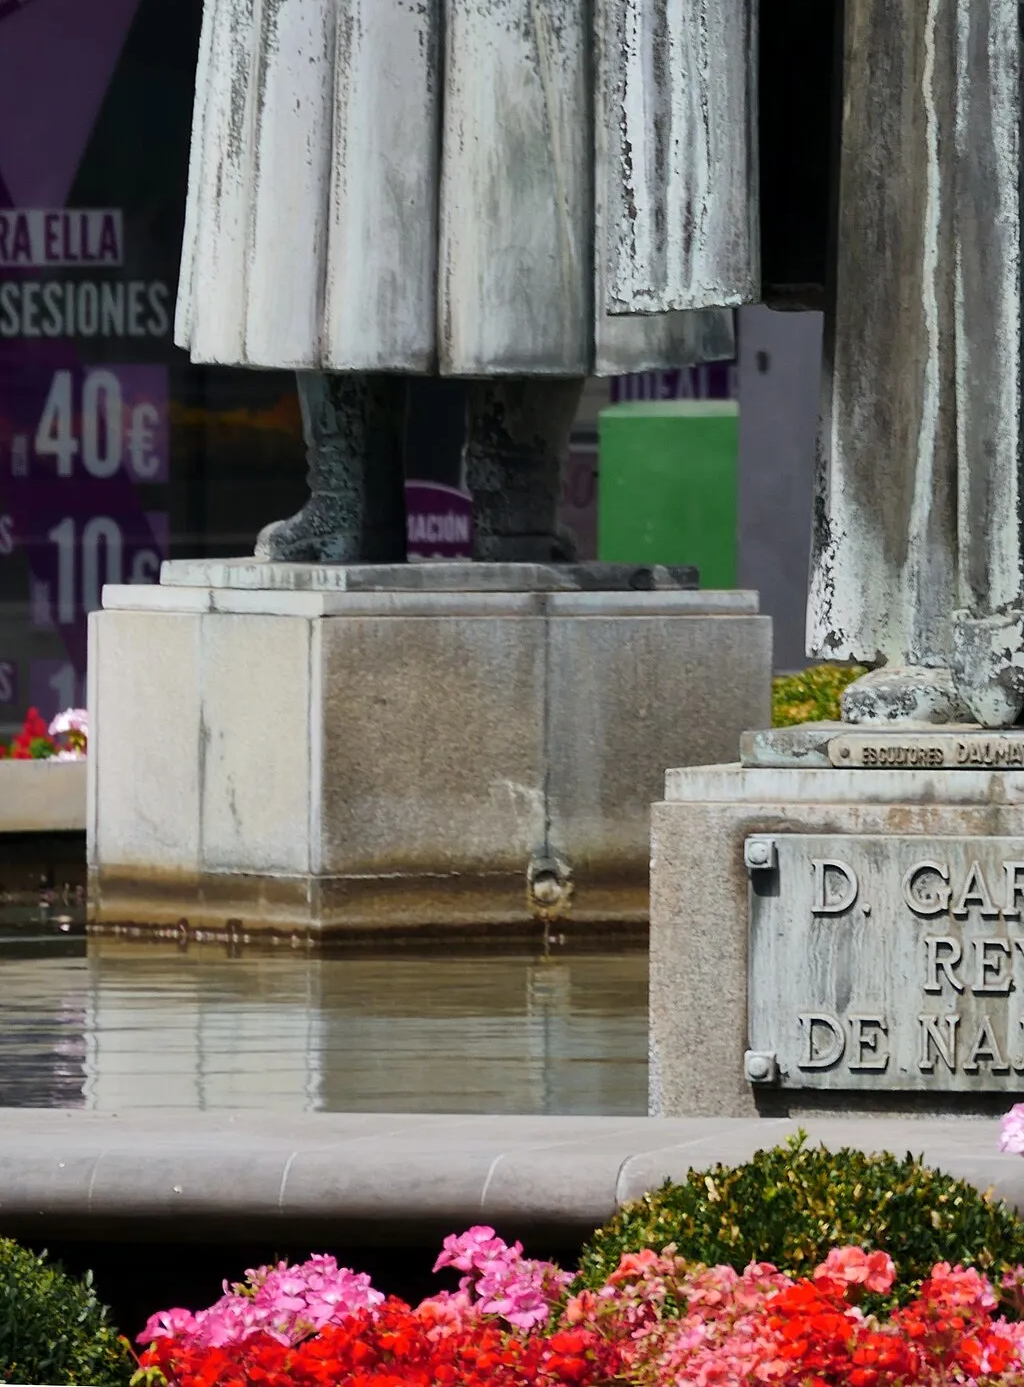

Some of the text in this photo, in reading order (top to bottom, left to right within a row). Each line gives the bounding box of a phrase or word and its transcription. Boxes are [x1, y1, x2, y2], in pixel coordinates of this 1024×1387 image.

[44, 214, 119, 271] ELLA
[0, 282, 170, 338] SESIONES
[35, 370, 160, 479] 40€
[861, 745, 944, 764] ESCULTORES
[811, 859, 872, 916] D.
[798, 1014, 890, 1071] DE
